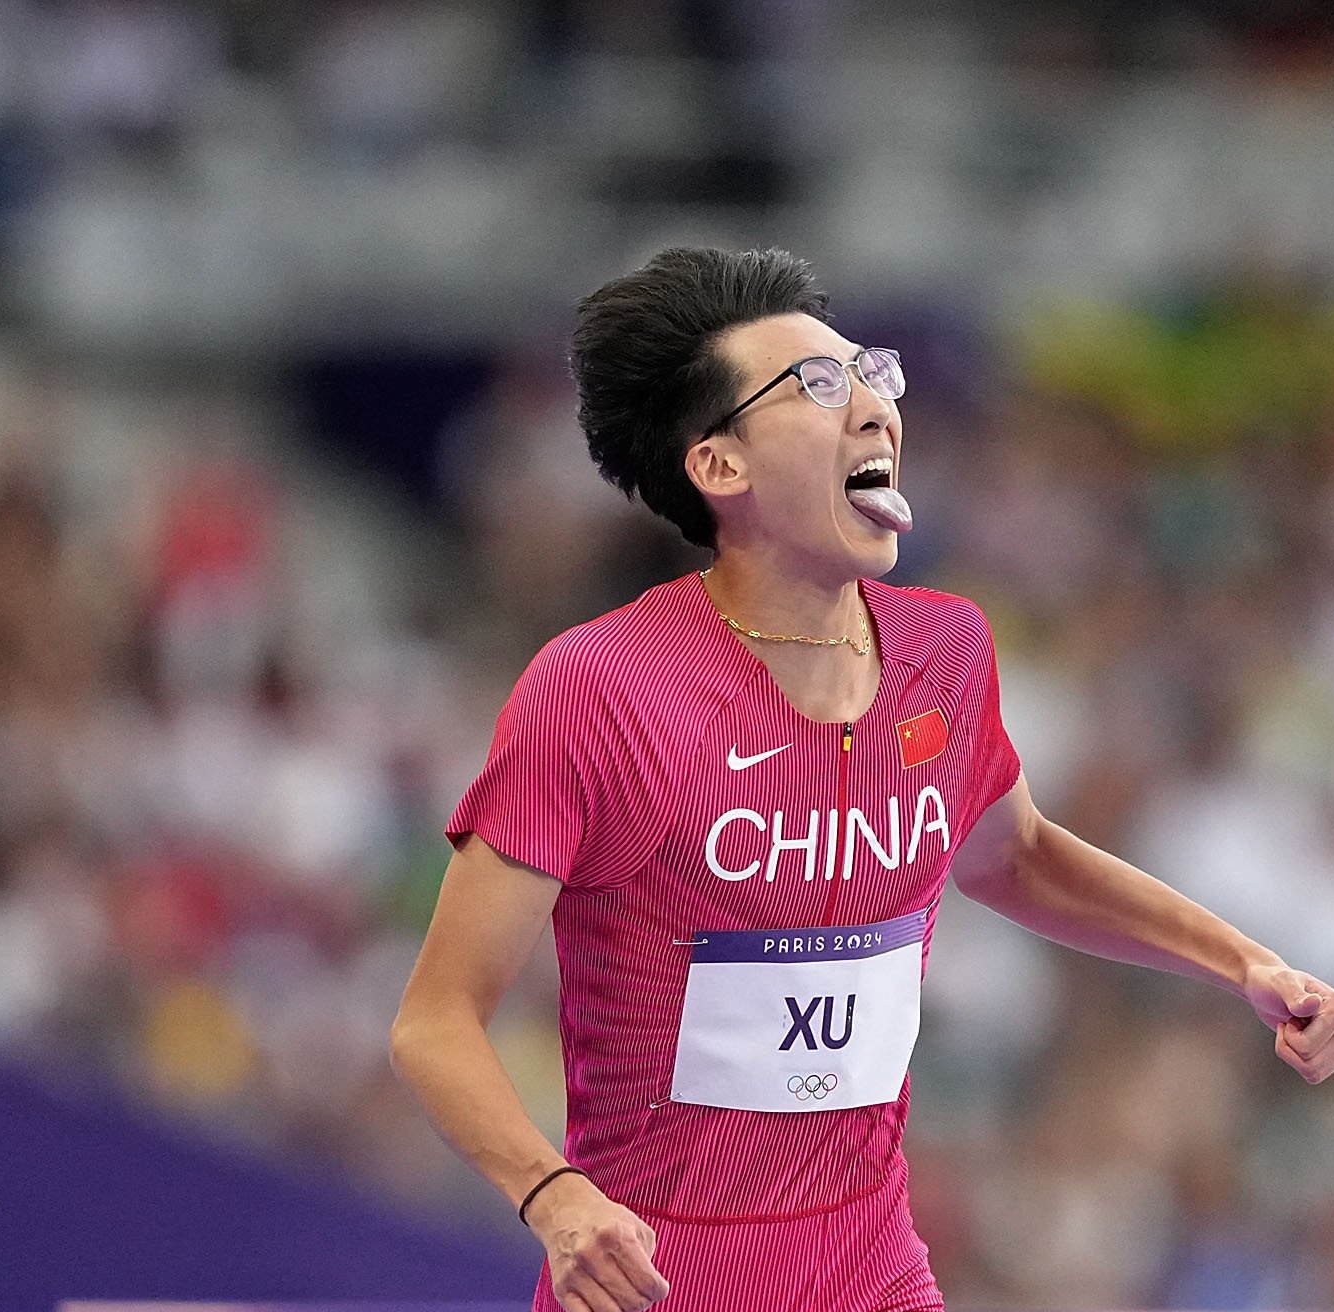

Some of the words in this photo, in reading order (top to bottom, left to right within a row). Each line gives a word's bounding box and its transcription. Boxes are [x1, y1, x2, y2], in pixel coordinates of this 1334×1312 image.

[705, 785, 950, 882] CHINA
[833, 931, 882, 951] 2024
[778, 994, 857, 1051] XU
